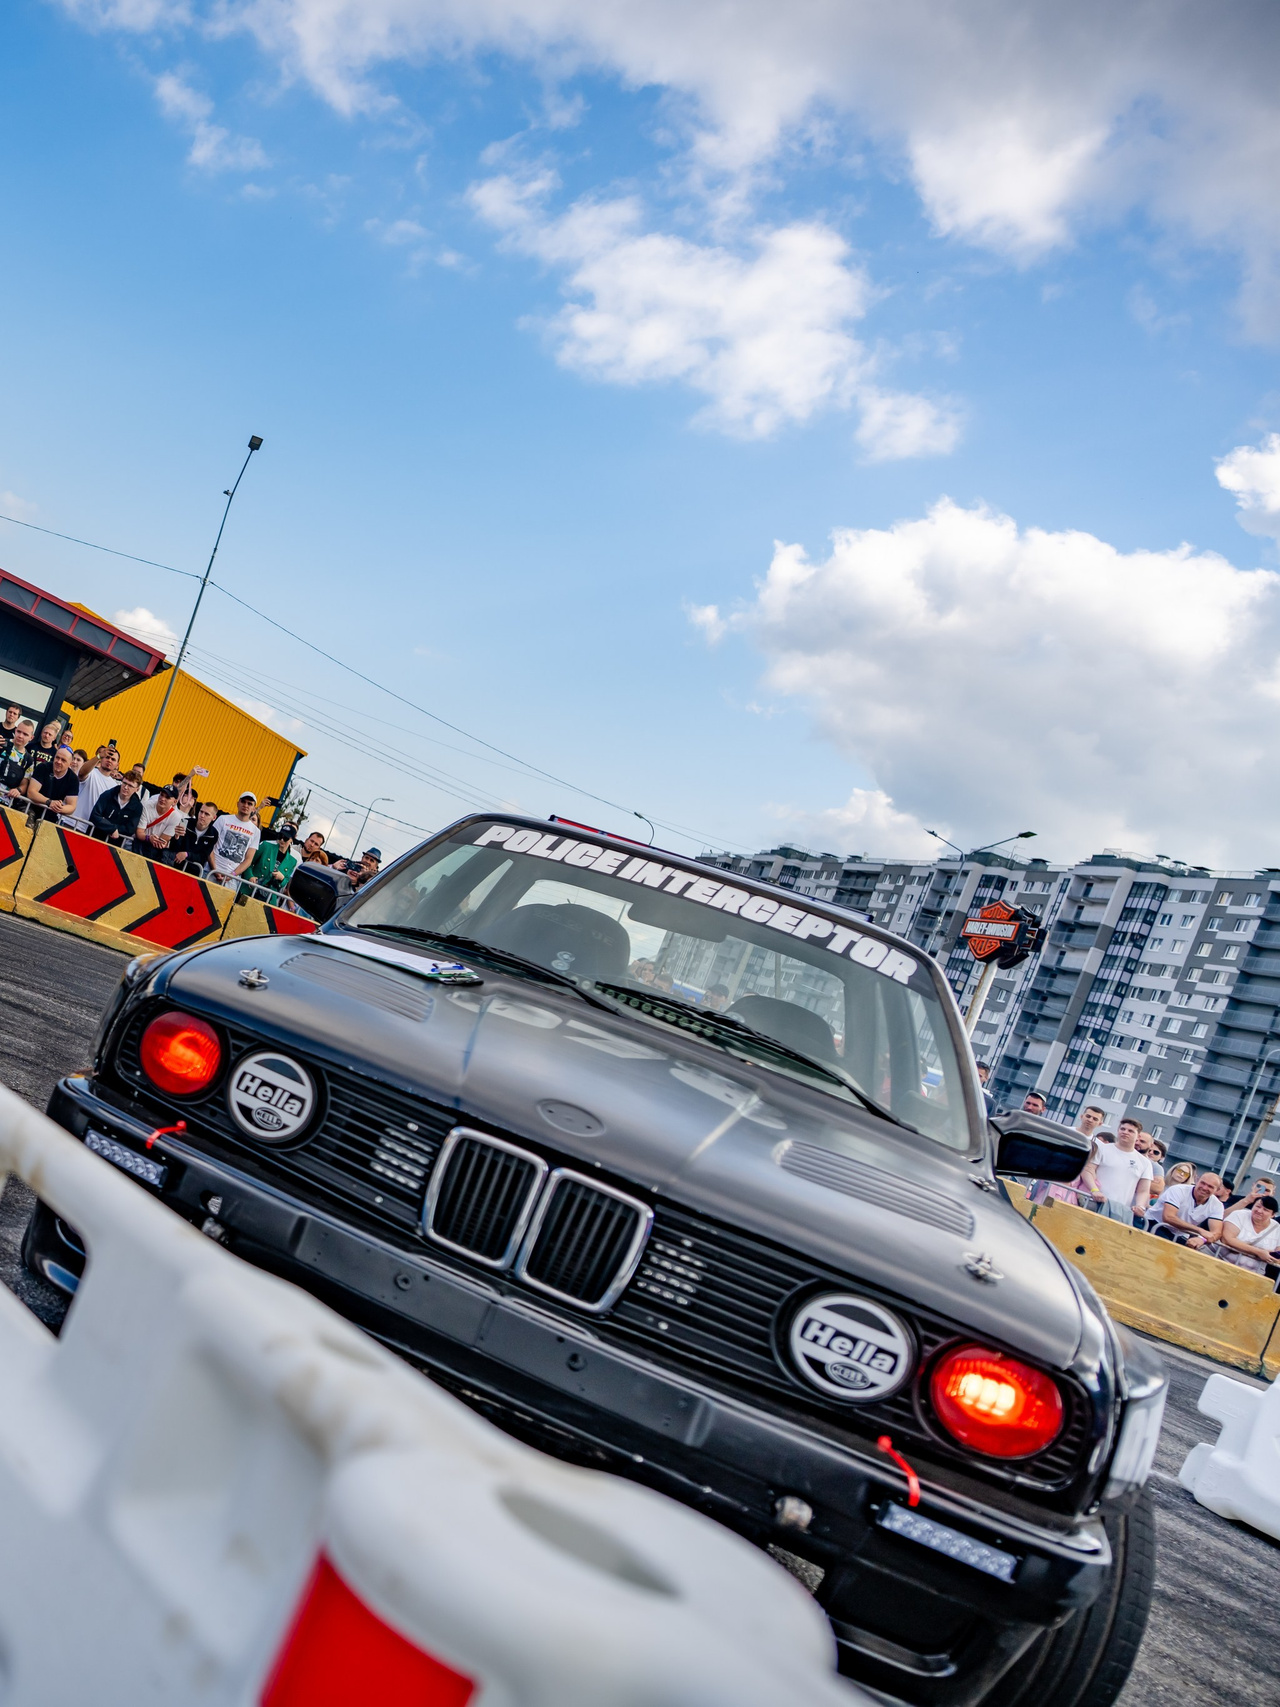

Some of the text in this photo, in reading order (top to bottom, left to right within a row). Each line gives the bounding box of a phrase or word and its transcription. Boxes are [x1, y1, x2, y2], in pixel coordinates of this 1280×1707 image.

[473, 825, 918, 985] POLICE INTERCEPTOR
[238, 1073, 302, 1116] Hella
[802, 1319, 896, 1374] Hella
